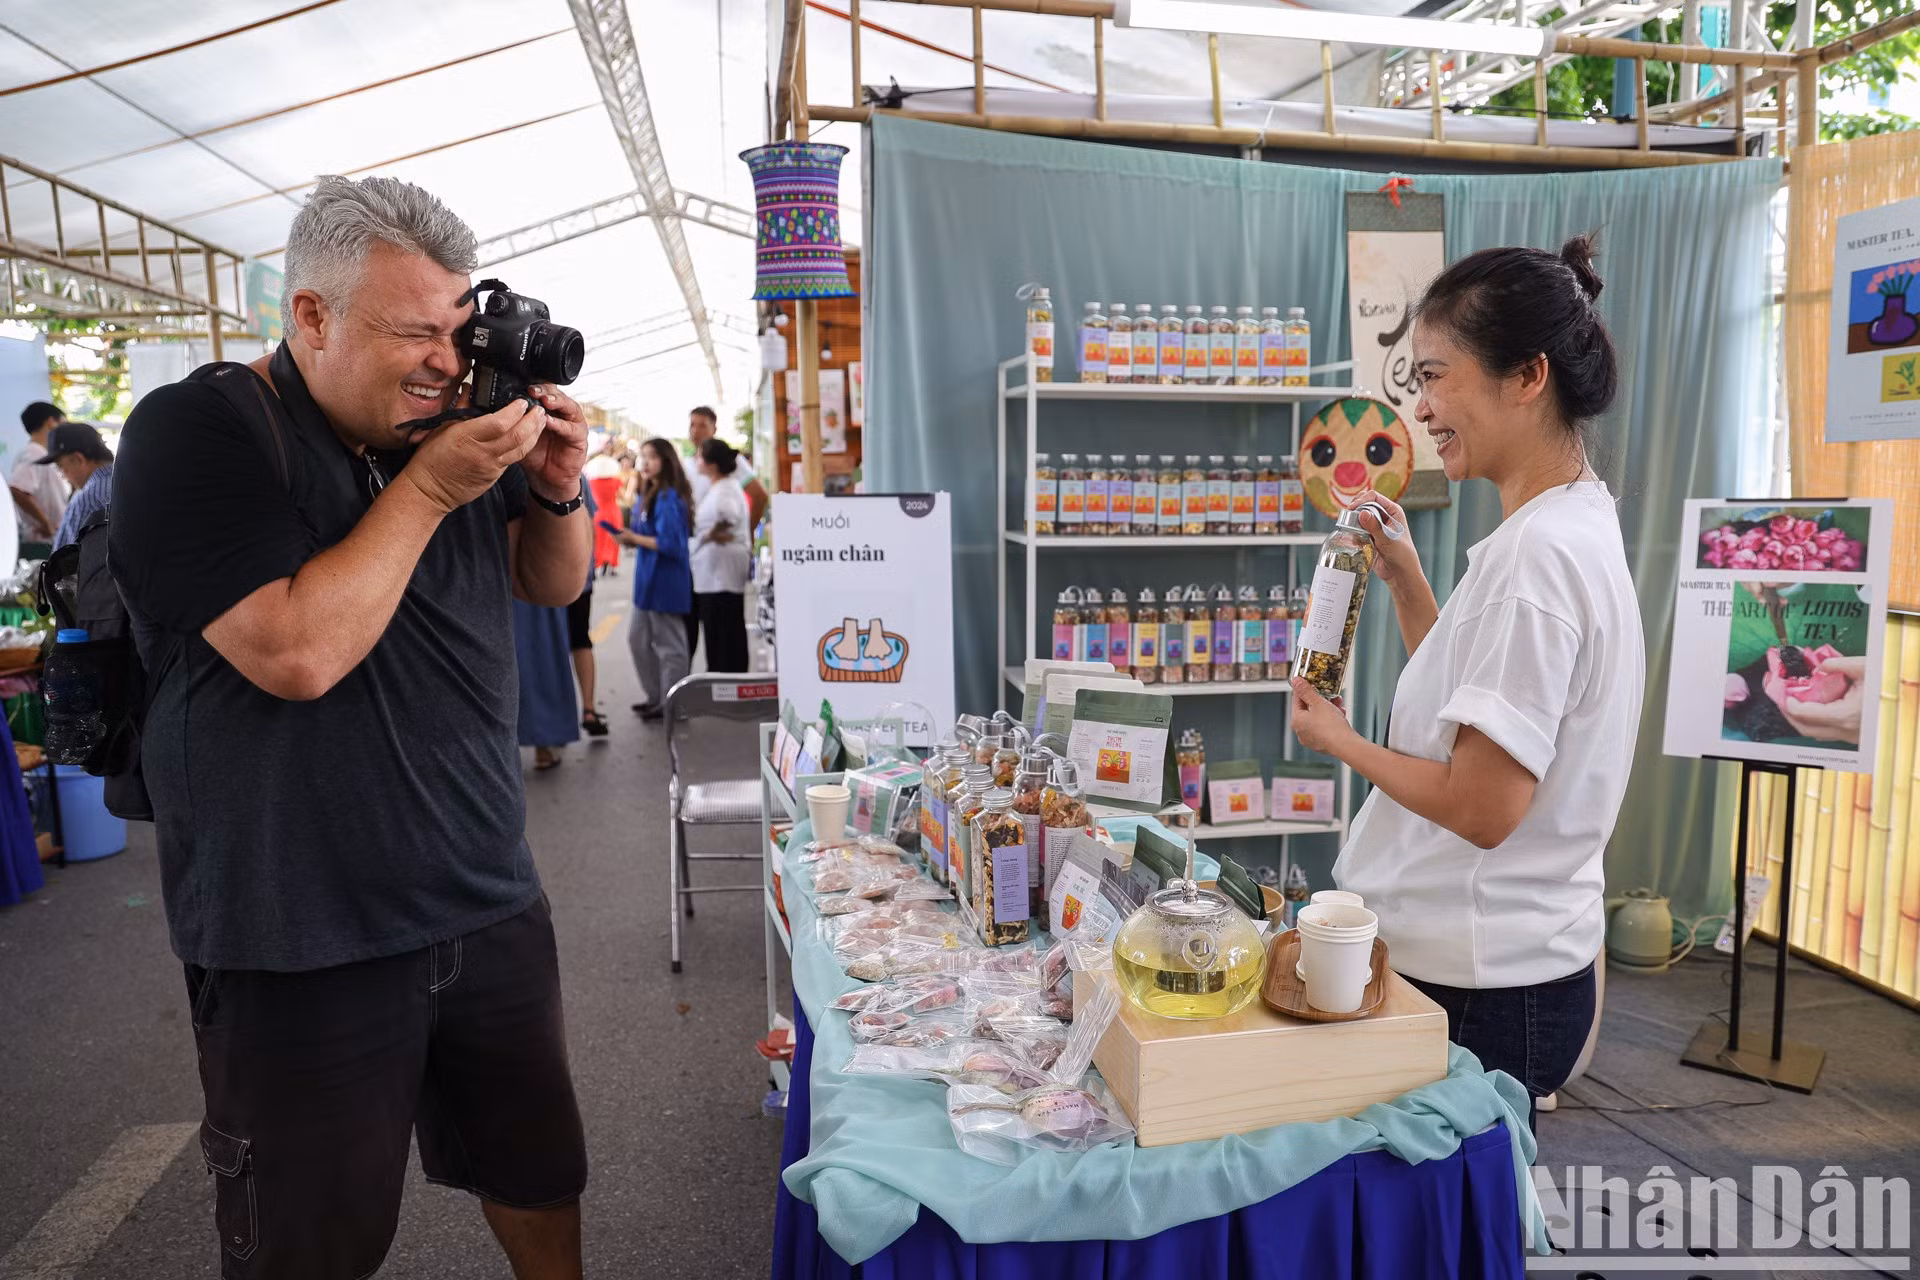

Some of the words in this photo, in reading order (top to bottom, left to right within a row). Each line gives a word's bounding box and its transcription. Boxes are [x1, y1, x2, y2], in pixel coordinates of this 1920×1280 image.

[1847, 233, 1888, 249] MASTER
[520, 333, 529, 360] Canon
[905, 500, 929, 511] 2024
[811, 510, 851, 529] MUỐI
[782, 544, 834, 565] ngâm
[839, 544, 886, 562] chân
[1680, 581, 1714, 590] MASTER
[1715, 582, 1732, 590] TEA
[1701, 600, 1732, 617] THE
[1740, 601, 1770, 618] ART
[1803, 600, 1865, 618] LOTUS
[1804, 623, 1837, 641] TEA
[904, 721, 929, 734] TEA
